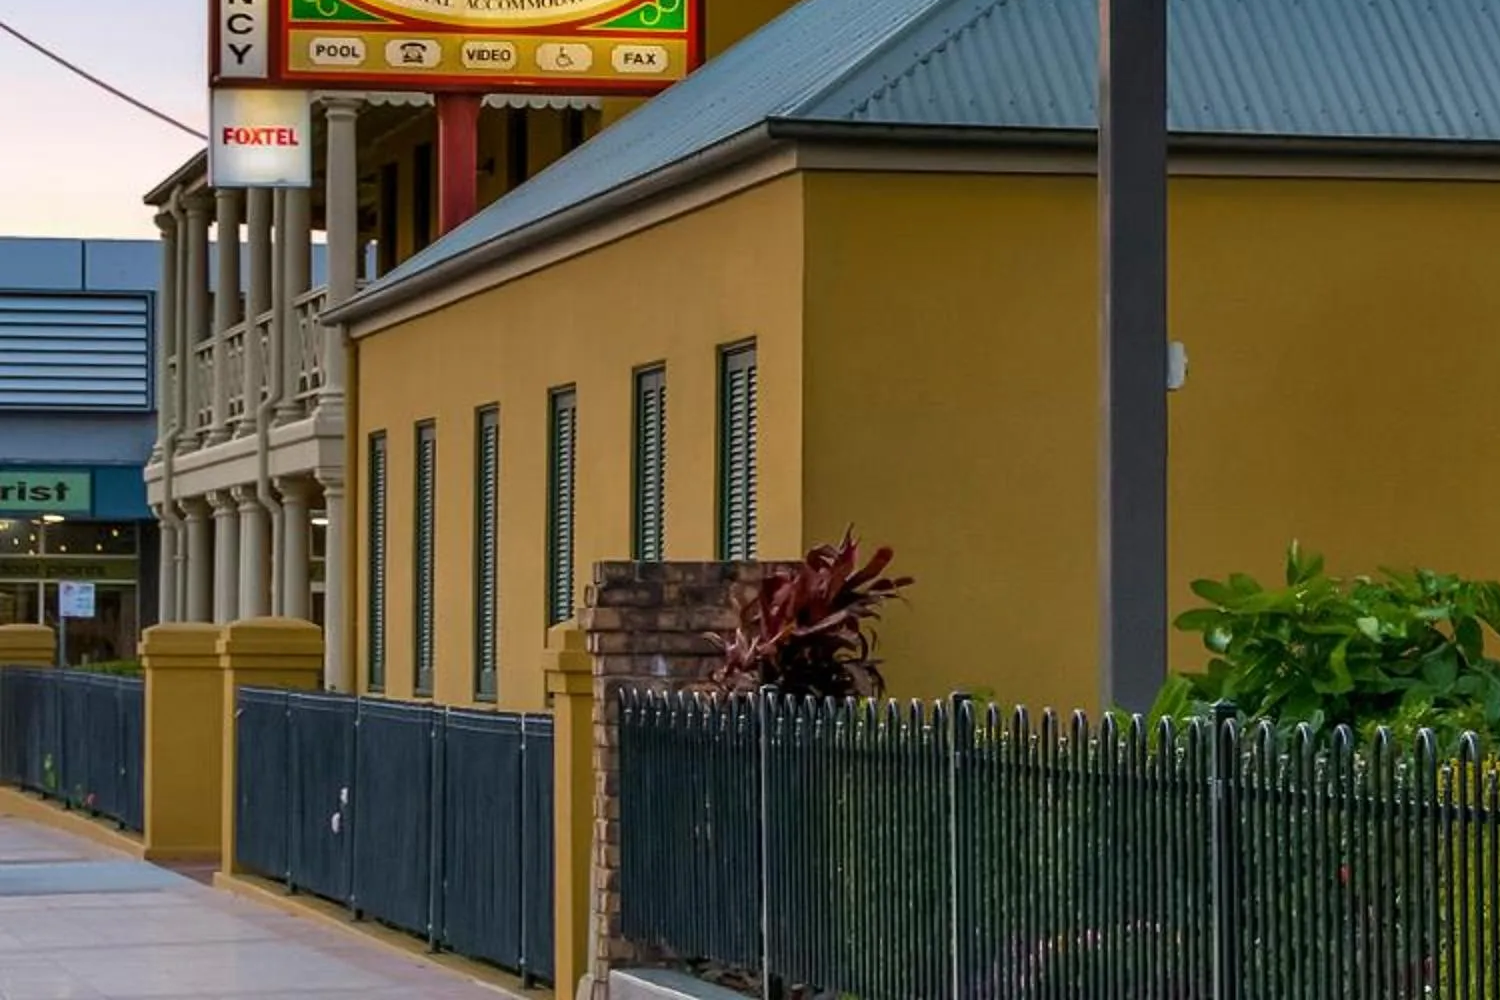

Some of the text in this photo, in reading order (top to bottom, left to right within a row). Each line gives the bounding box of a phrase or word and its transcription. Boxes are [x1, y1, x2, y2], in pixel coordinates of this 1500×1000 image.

[315, 45, 361, 59] POOL
[466, 50, 512, 64] VIDEO
[623, 54, 656, 66] FAX
[223, 128, 299, 147] FOXTEL
